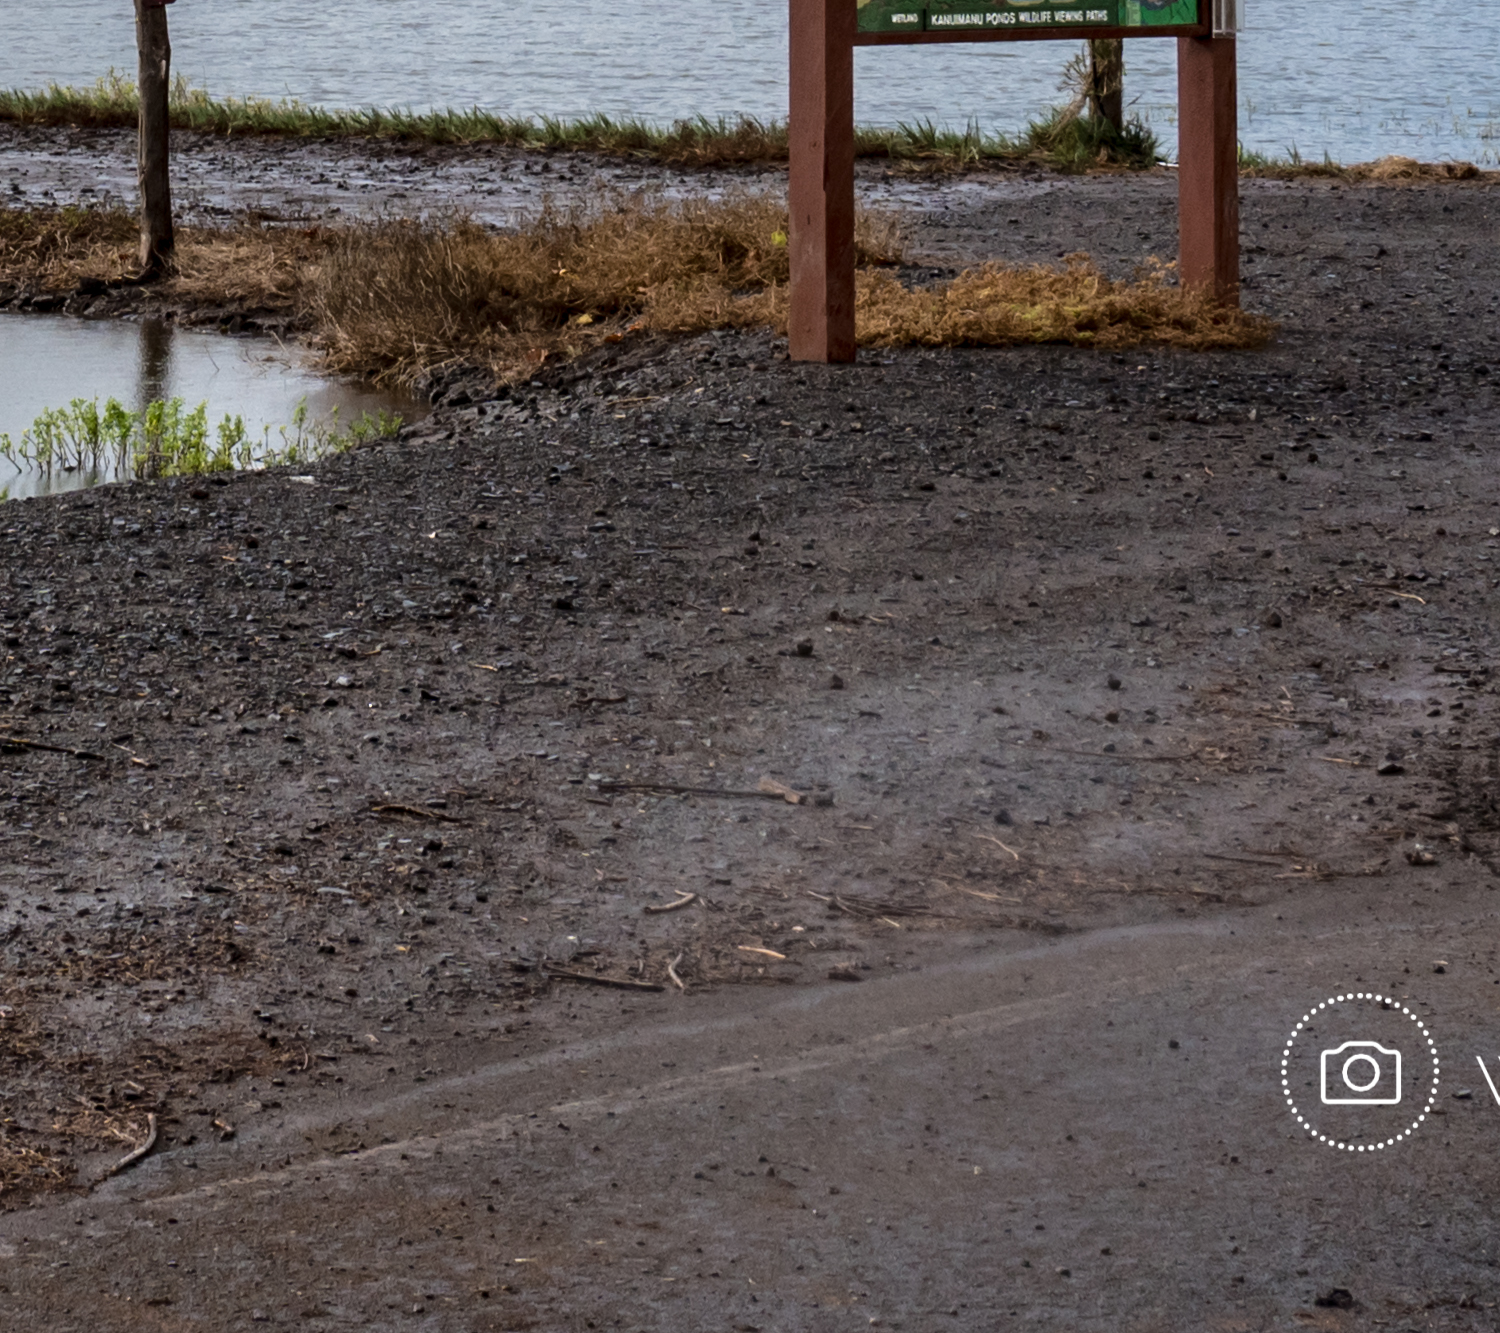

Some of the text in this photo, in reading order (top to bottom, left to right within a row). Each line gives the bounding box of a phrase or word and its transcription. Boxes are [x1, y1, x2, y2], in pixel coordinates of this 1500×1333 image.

[931, 9, 1108, 25] KANUIMANU PONDS WILDLIFE VIEWING PATHS
